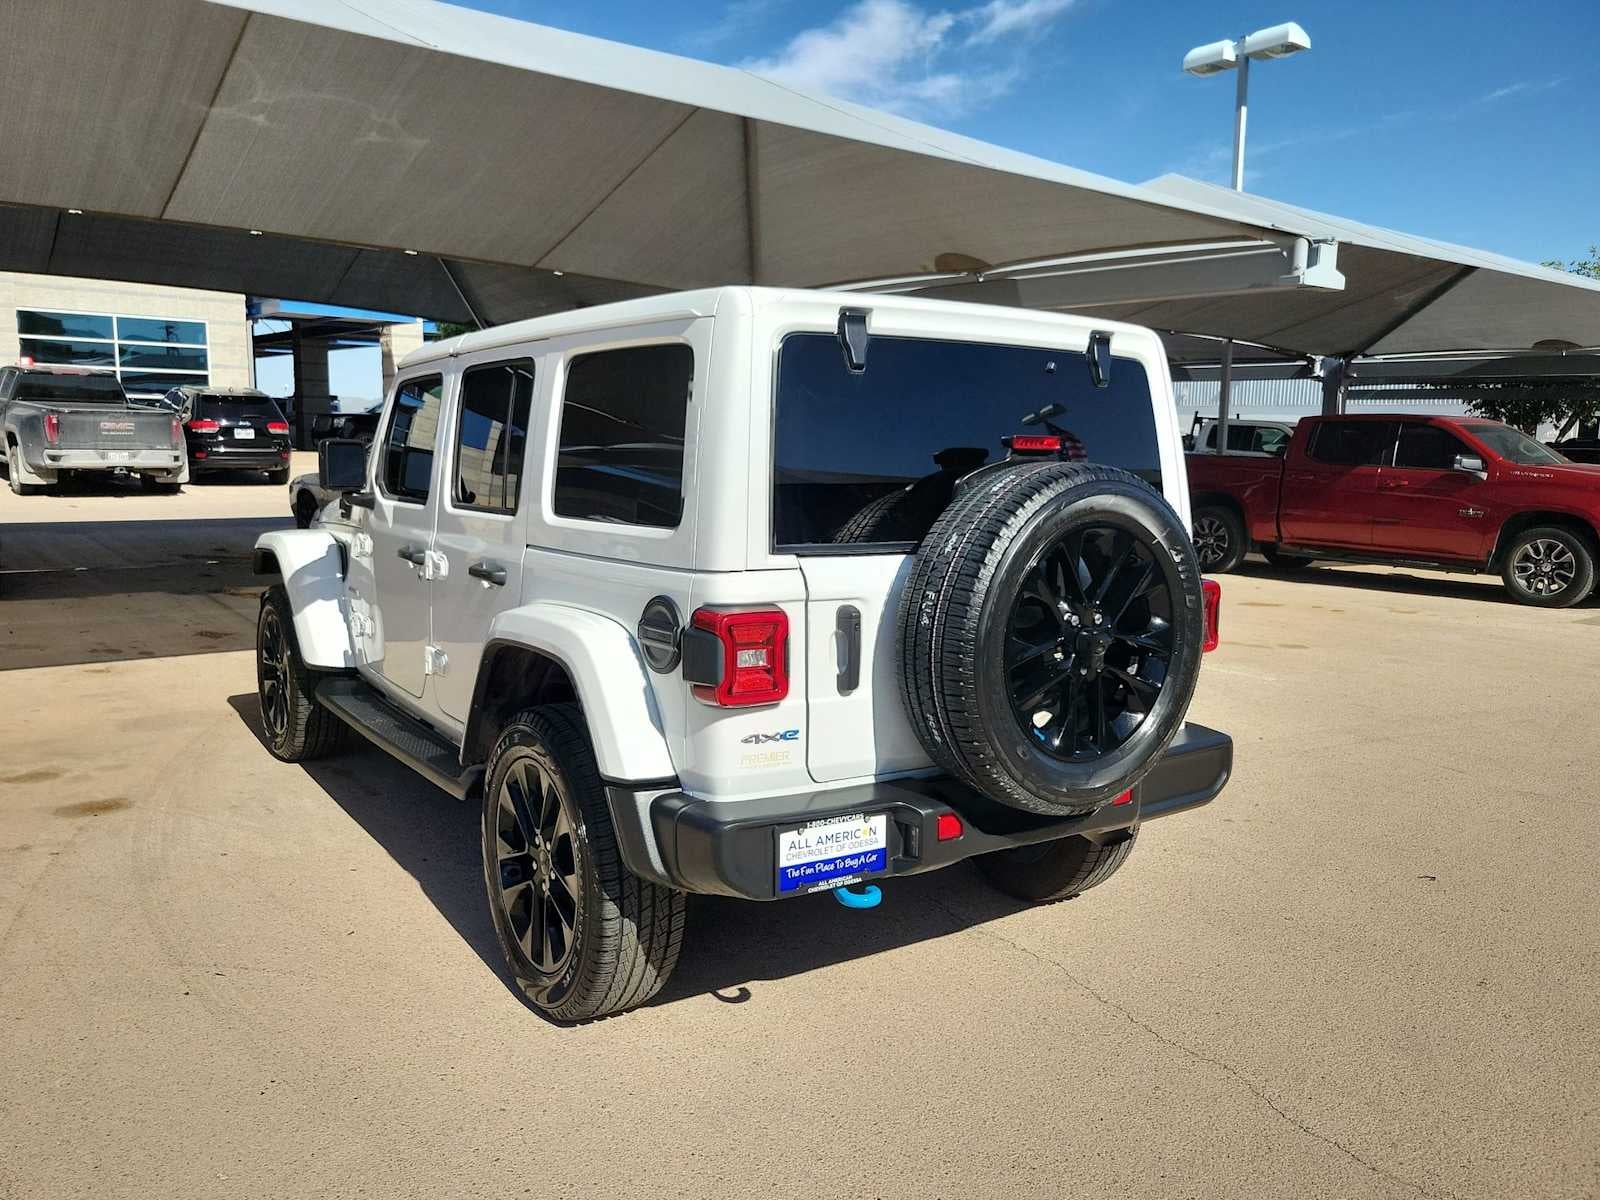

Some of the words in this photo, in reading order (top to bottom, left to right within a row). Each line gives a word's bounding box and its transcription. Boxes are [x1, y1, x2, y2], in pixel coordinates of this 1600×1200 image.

[785, 846, 834, 861] CHEVROLET
[836, 844, 847, 853] OF
[848, 838, 879, 850] ODESSA
[788, 838, 811, 851] ALL
[816, 826, 877, 846] AMERICN
[786, 868, 800, 879] The
[800, 866, 815, 876] Fun
[815, 862, 835, 873] Place
[835, 859, 845, 869] To
[845, 857, 859, 869] Buy
[859, 855, 865, 864] A
[865, 853, 878, 862] Car
